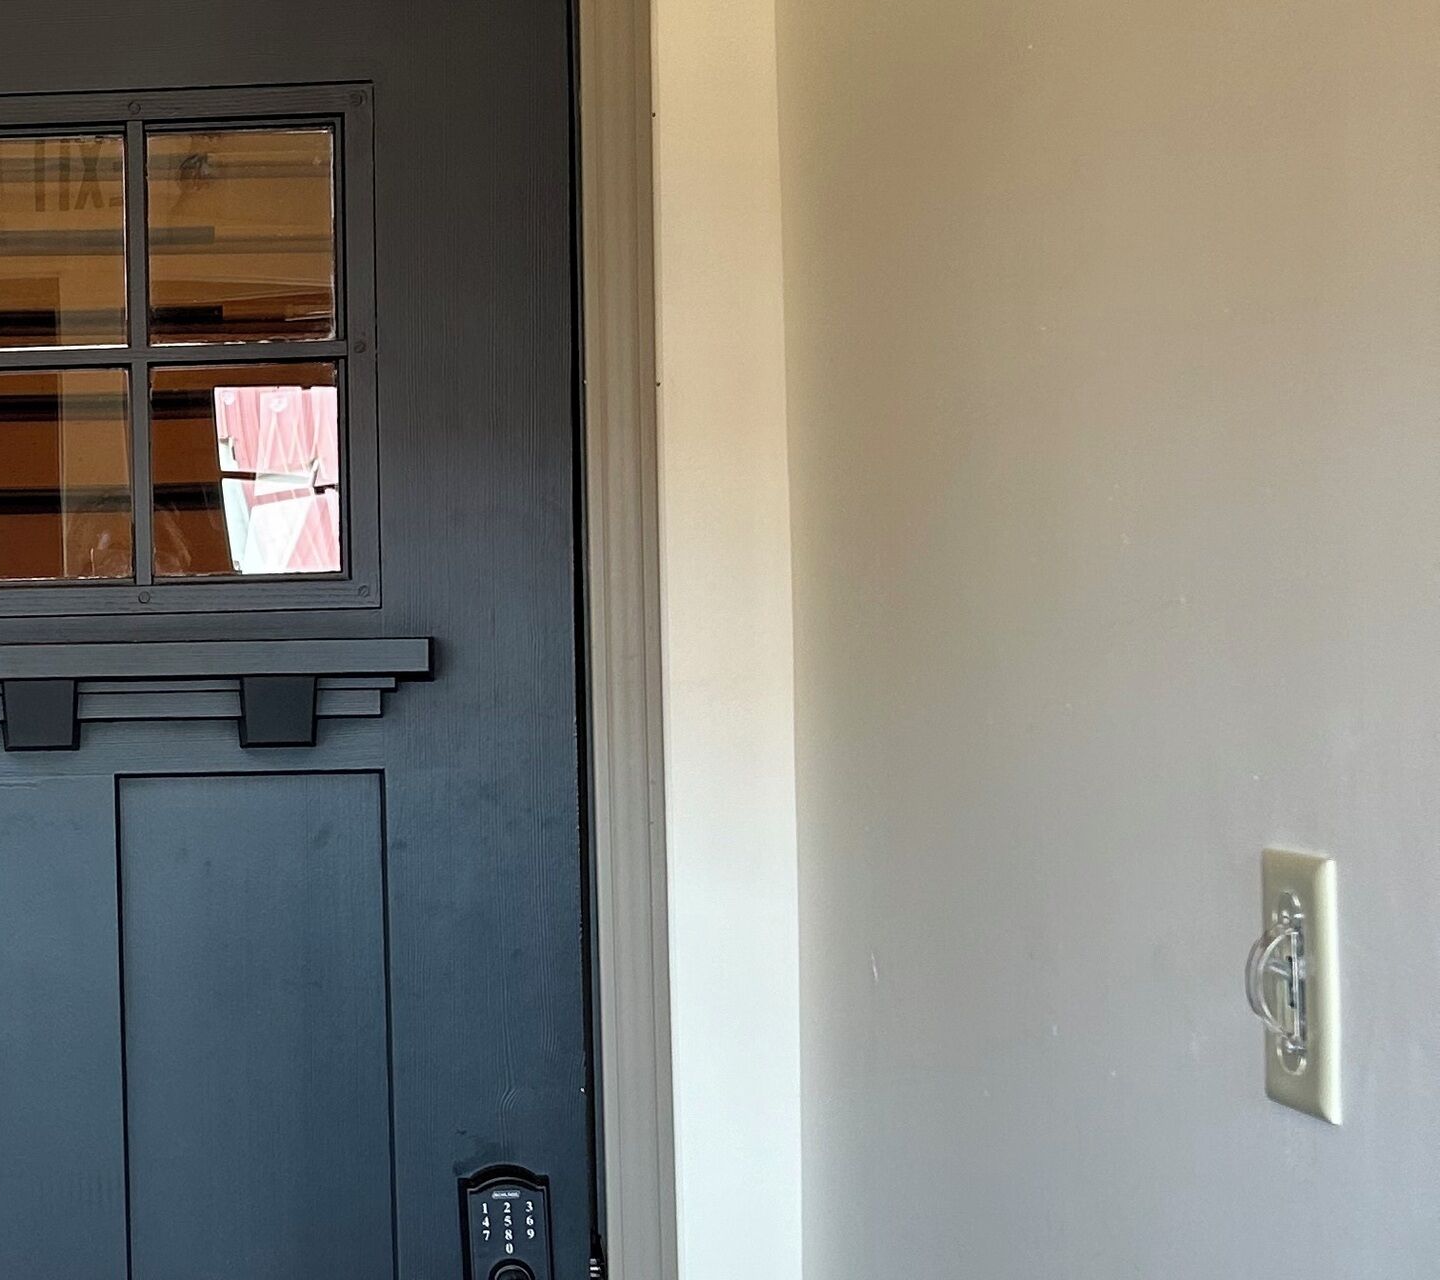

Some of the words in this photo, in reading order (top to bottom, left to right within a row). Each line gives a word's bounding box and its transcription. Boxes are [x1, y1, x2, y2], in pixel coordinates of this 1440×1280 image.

[481, 1202, 489, 1214] 1
[503, 1201, 511, 1214] 2
[525, 1200, 534, 1213] 3
[481, 1216, 490, 1228] 4
[503, 1215, 513, 1227] 5
[526, 1214, 534, 1226] 6
[482, 1229, 491, 1241] 7
[504, 1229, 513, 1241] 8
[526, 1228, 535, 1240] 9
[505, 1242, 514, 1255] 0
